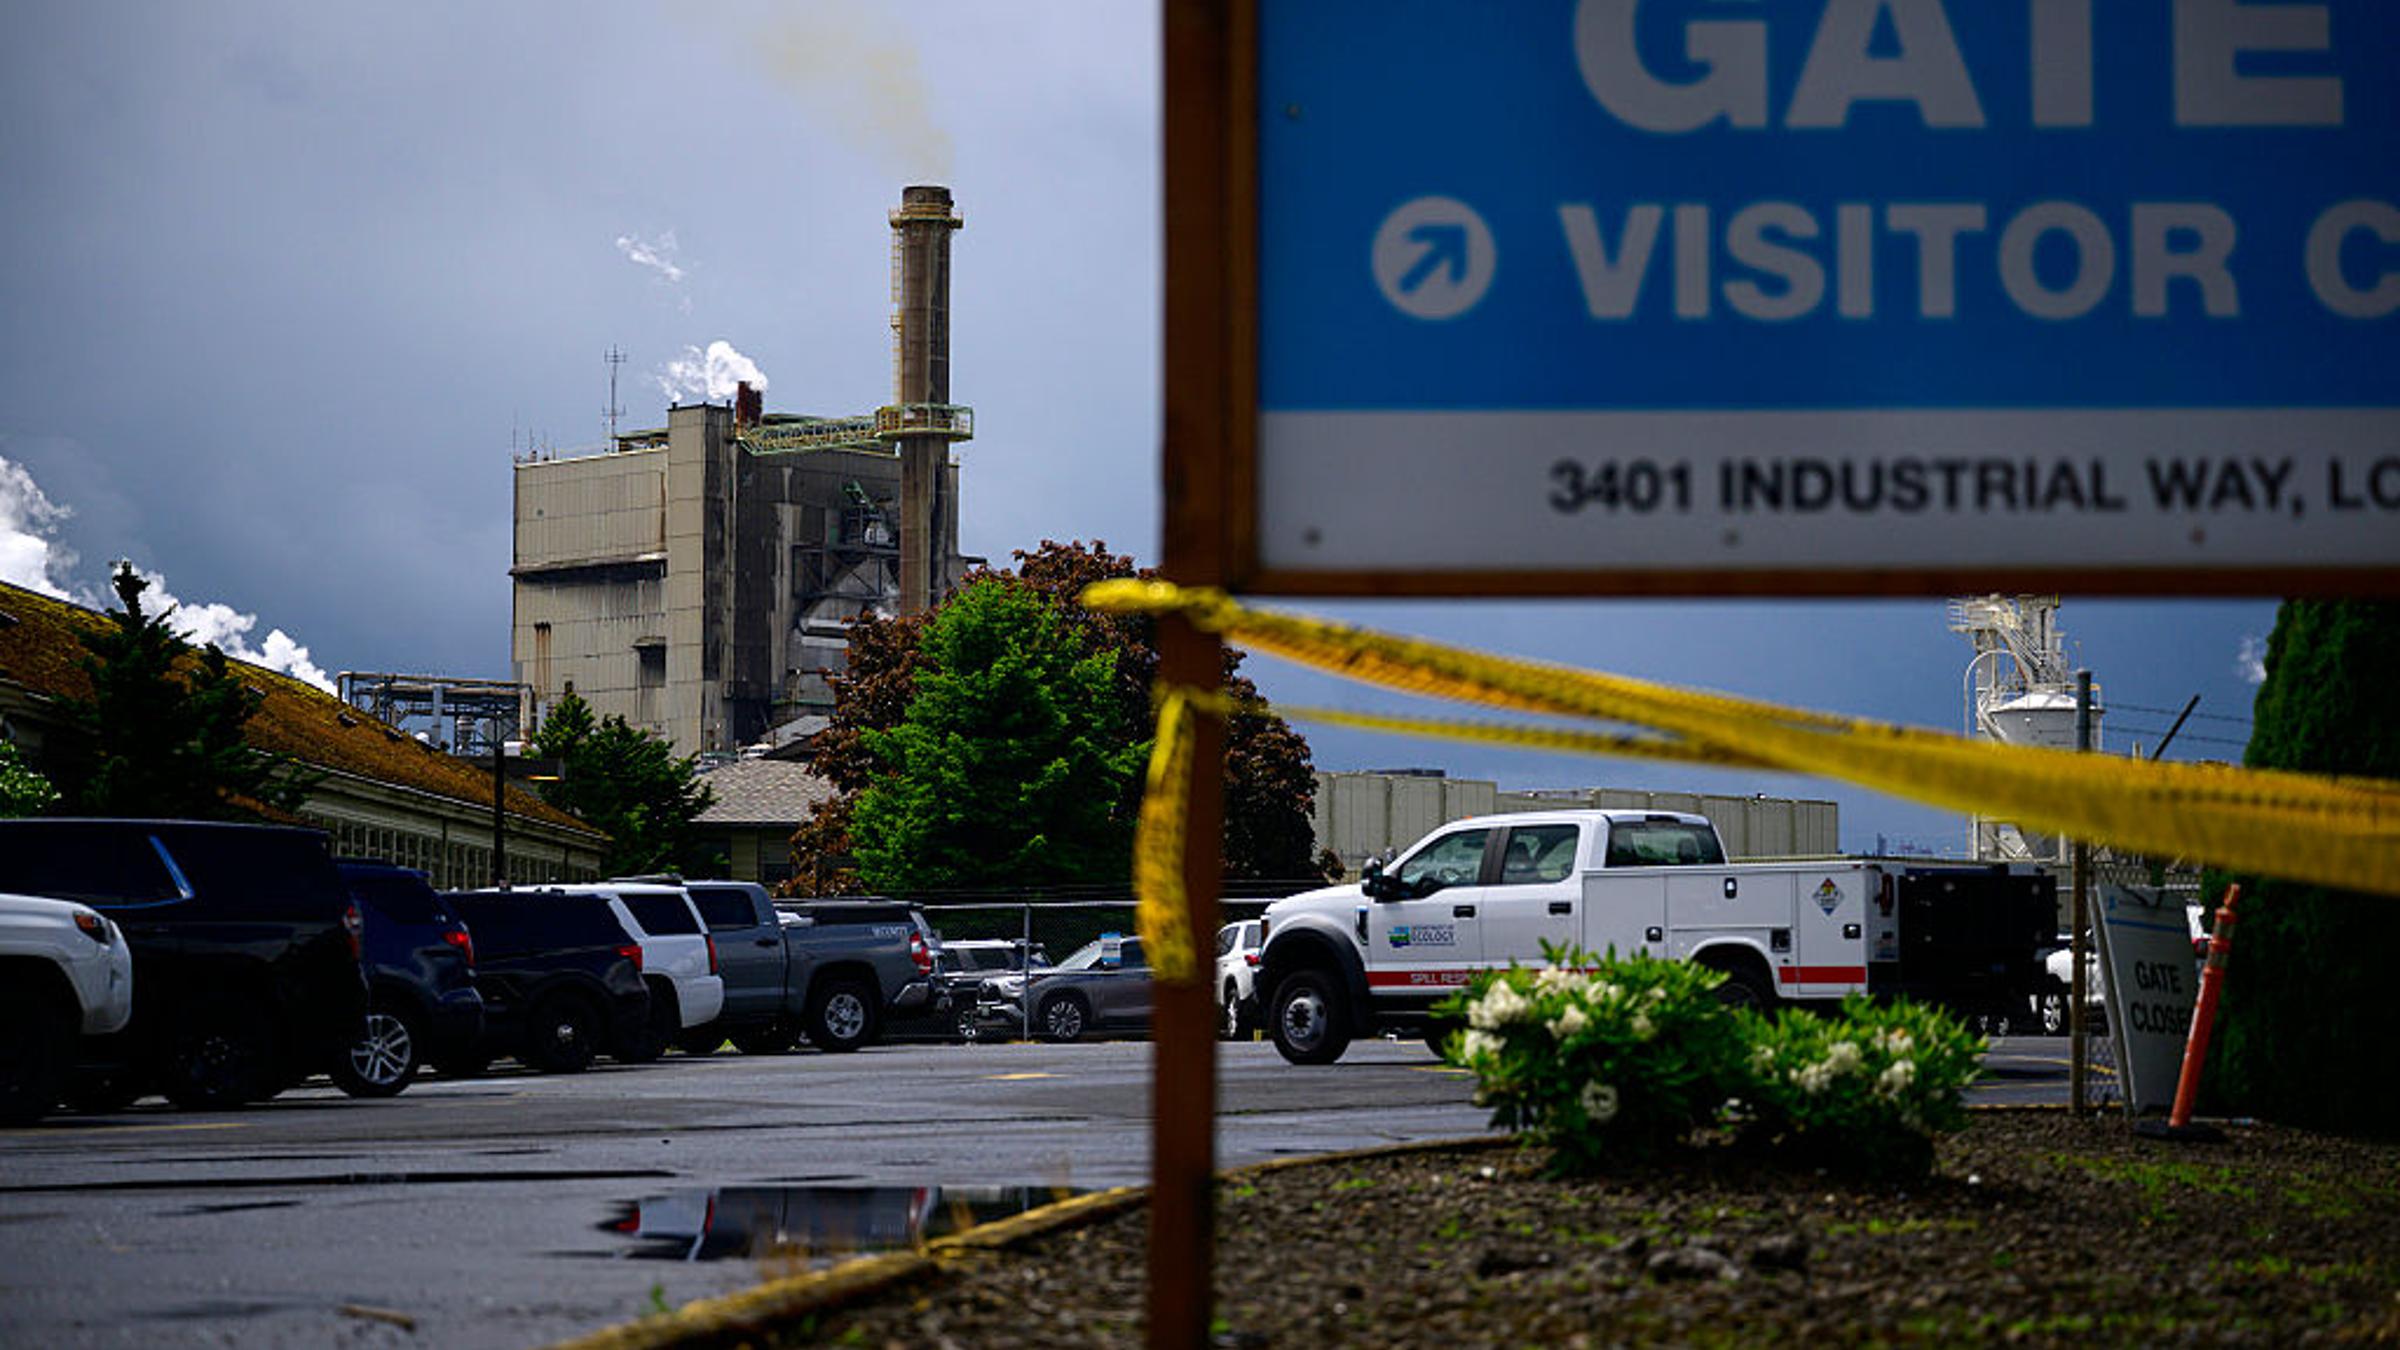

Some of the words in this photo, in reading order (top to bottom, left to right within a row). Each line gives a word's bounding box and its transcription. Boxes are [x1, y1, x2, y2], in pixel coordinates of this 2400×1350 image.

[1574, 0, 2343, 132] GATE
[1559, 202, 2238, 320] VISITOR
[1550, 458, 1692, 514] 3401
[1719, 458, 2126, 514] INDUSTRIAL
[2146, 457, 2304, 520] WAY,
[2135, 961, 2182, 993] GATE
